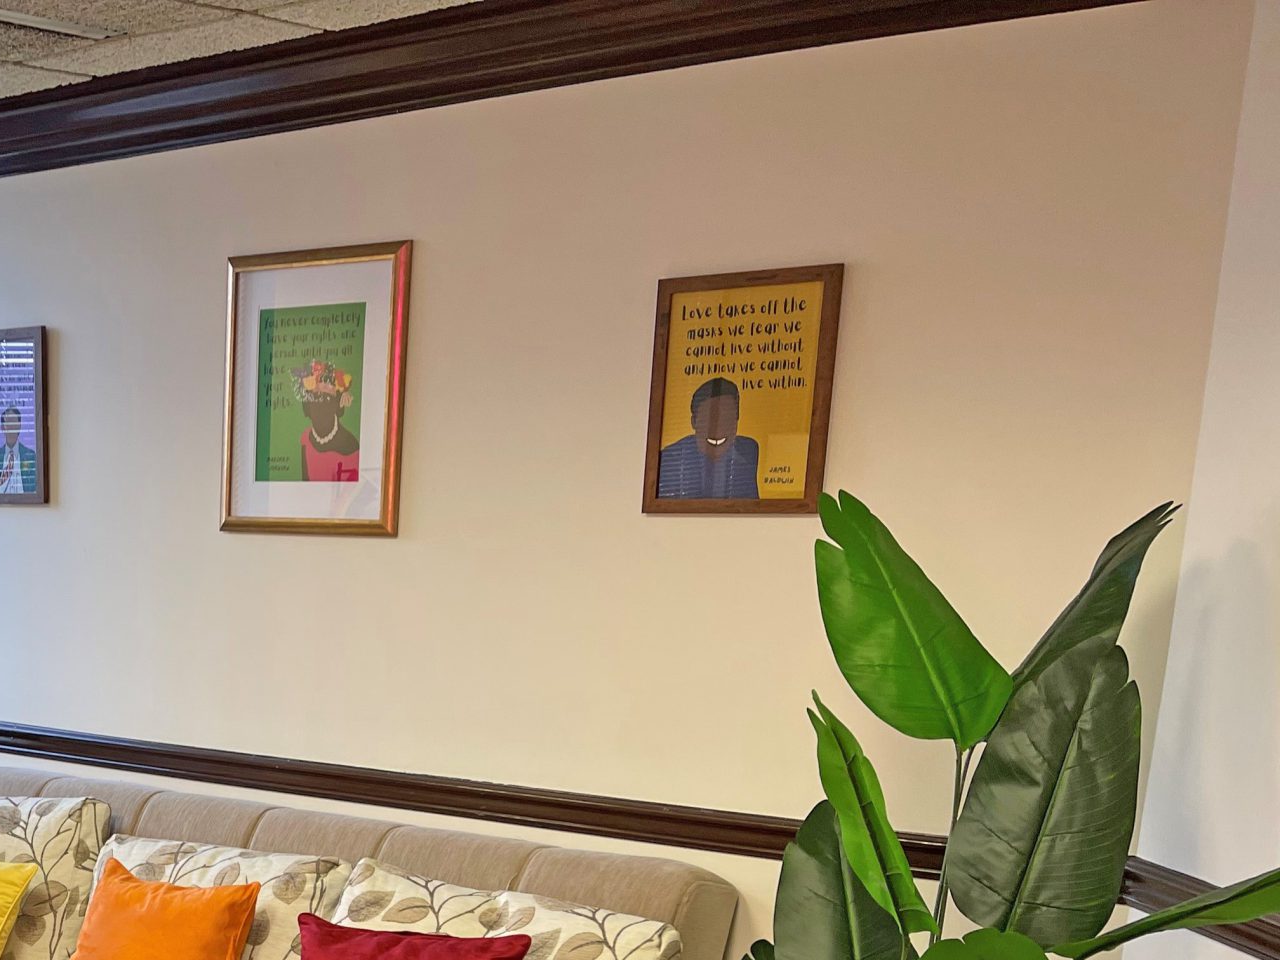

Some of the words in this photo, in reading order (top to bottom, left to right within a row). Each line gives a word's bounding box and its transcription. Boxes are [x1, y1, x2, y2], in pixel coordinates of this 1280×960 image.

[681, 304, 712, 321] Love
[717, 302, 756, 319] takes
[760, 299, 778, 315] off
[783, 296, 807, 314] the
[280, 316, 307, 328] never
[310, 311, 361, 328] completely
[686, 326, 724, 340] masks
[727, 324, 745, 337] we
[750, 321, 780, 336] fear
[783, 320, 802, 334] we
[685, 342, 726, 358] cannot
[730, 341, 753, 355] live
[757, 337, 804, 354] without
[683, 362, 705, 376] and
[707, 362, 736, 375] know
[739, 361, 756, 373] we
[759, 356, 803, 372] cannot
[741, 378, 765, 390] live
[768, 375, 807, 390] within.
[768, 465, 791, 473] JAMES
